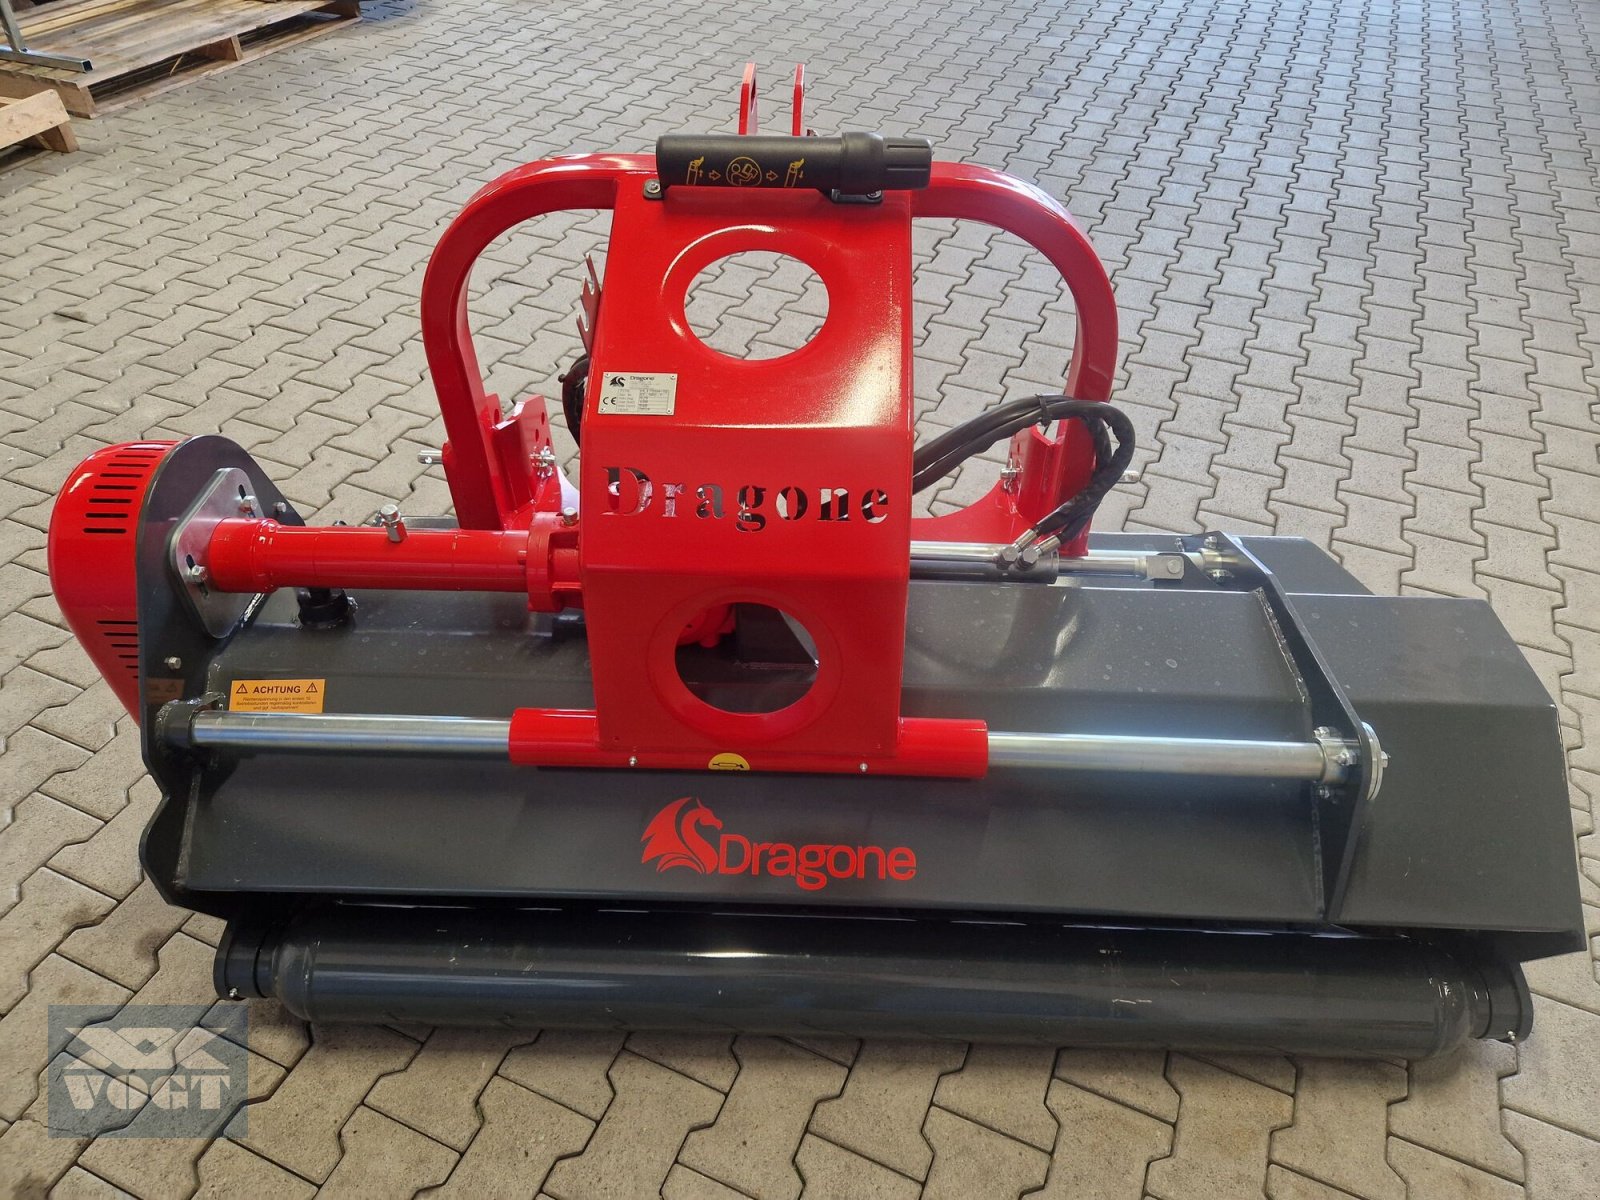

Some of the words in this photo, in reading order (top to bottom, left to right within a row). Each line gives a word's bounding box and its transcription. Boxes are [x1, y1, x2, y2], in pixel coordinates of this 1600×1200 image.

[600, 466, 889, 533] Dragone
[252, 685, 301, 694] ACHTUNG
[718, 833, 917, 890] Dragone
